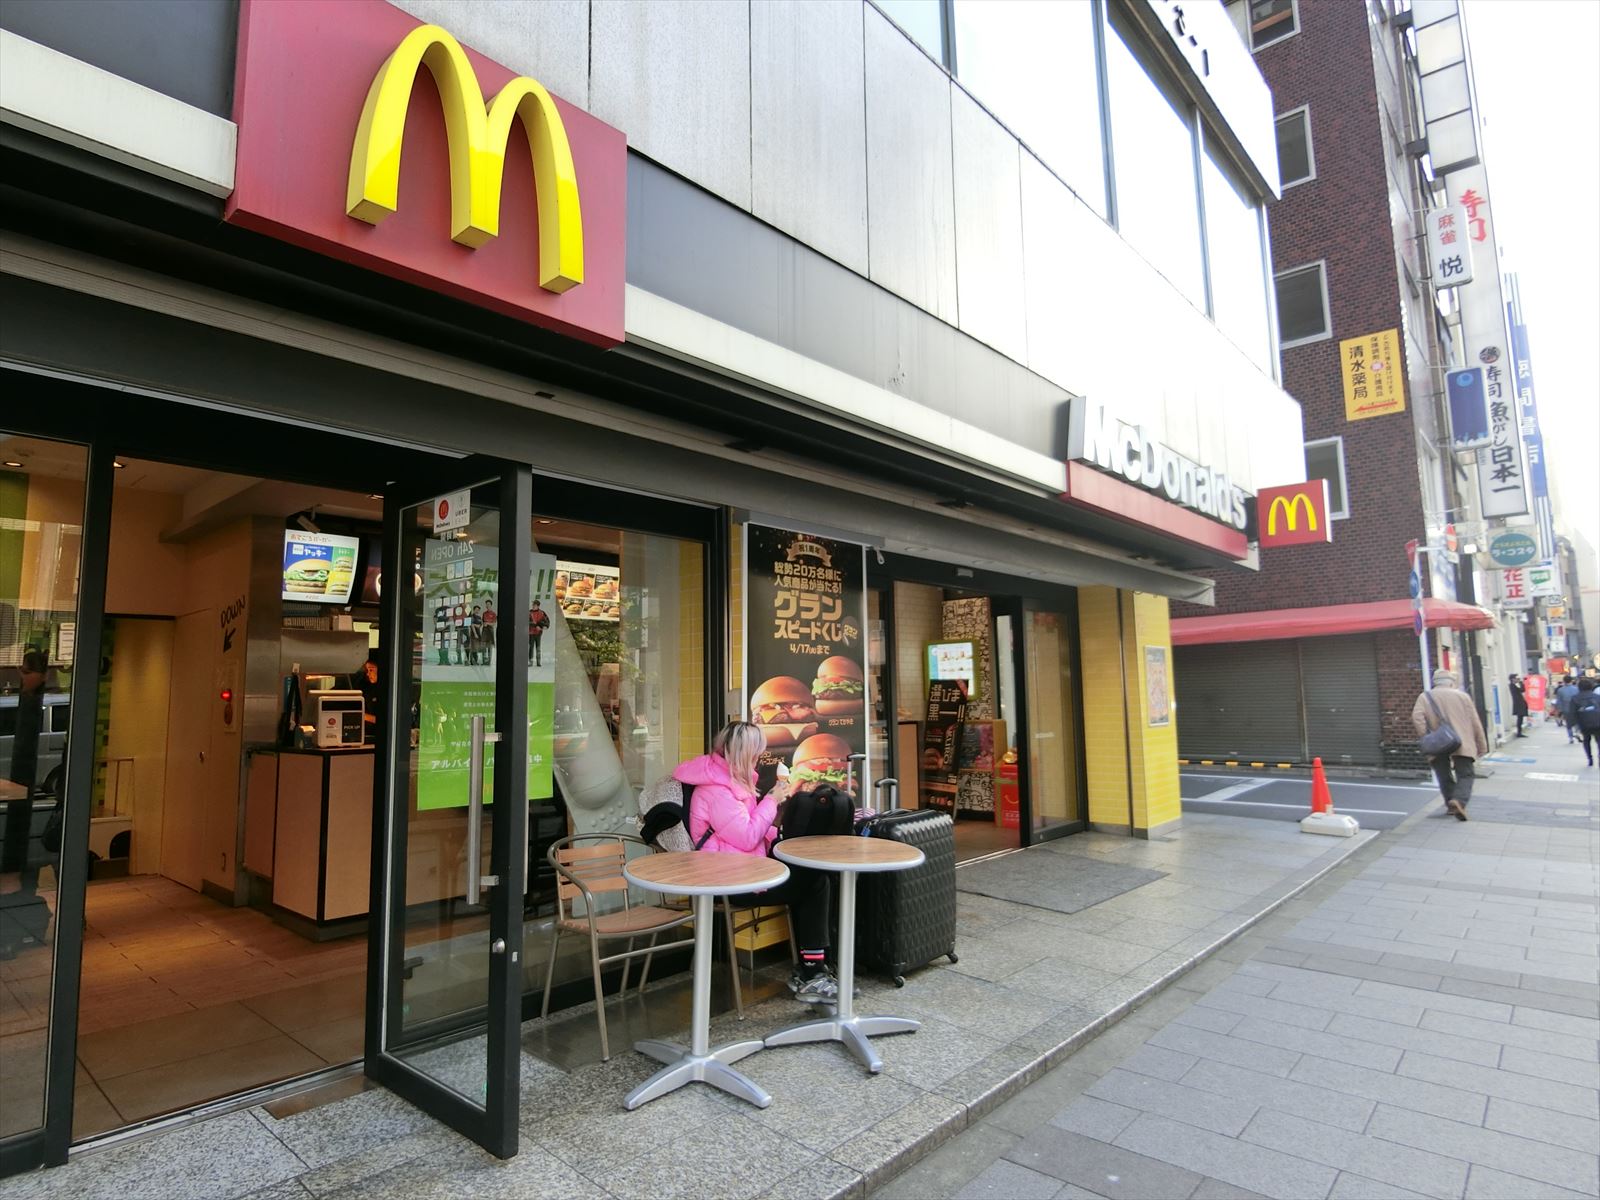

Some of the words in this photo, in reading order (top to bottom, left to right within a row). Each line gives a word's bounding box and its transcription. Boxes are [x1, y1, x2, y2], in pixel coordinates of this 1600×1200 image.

[1439, 255, 1464, 278] 悦
[1348, 344, 1368, 400] 清水薬局
[774, 561, 842, 581] 総勢20万名様に
[220, 594, 246, 629] DOWN
[774, 590, 842, 621] グラン
[774, 619, 842, 641] スピードくじ
